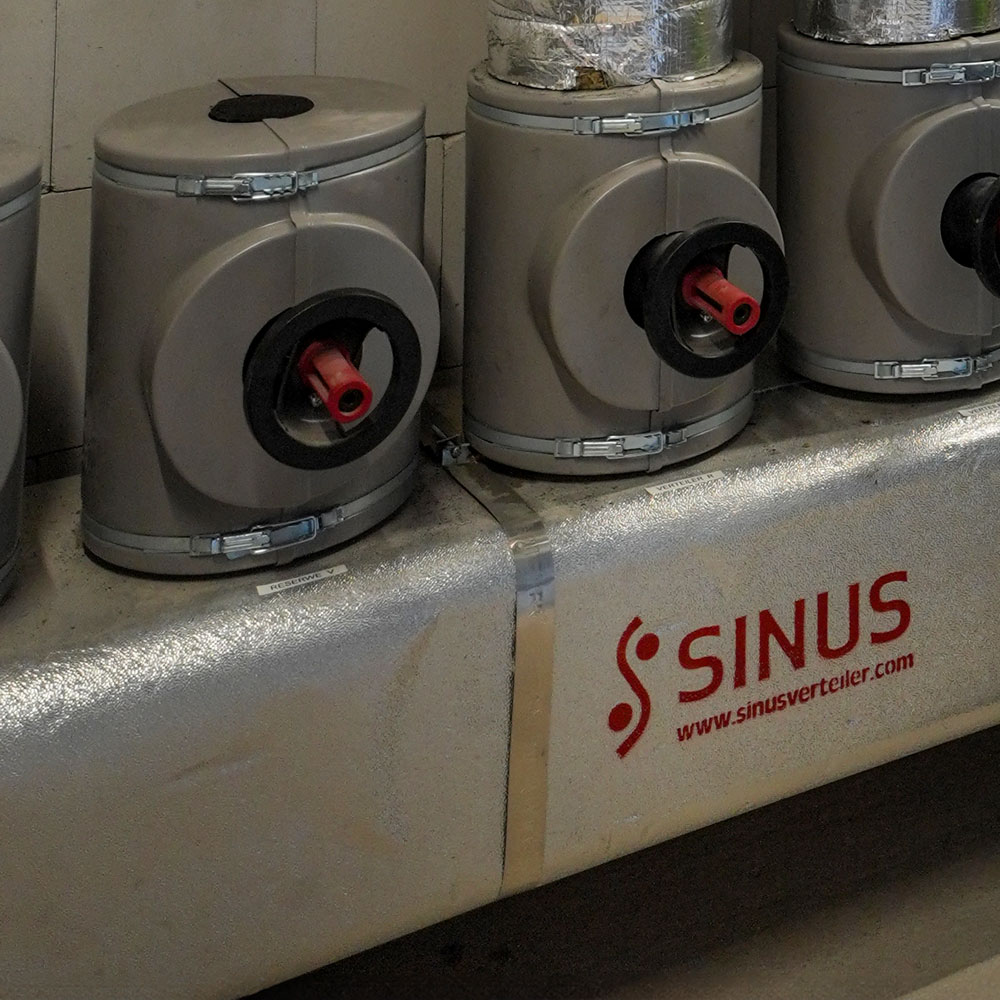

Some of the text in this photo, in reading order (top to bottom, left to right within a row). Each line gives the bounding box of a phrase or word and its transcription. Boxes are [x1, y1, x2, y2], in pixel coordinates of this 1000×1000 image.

[656, 476, 704, 491] VERTEILER
[270, 573, 321, 591] RESERWE
[678, 570, 911, 703] SINUS
[676, 652, 915, 742] www.sinusverteiler.com
